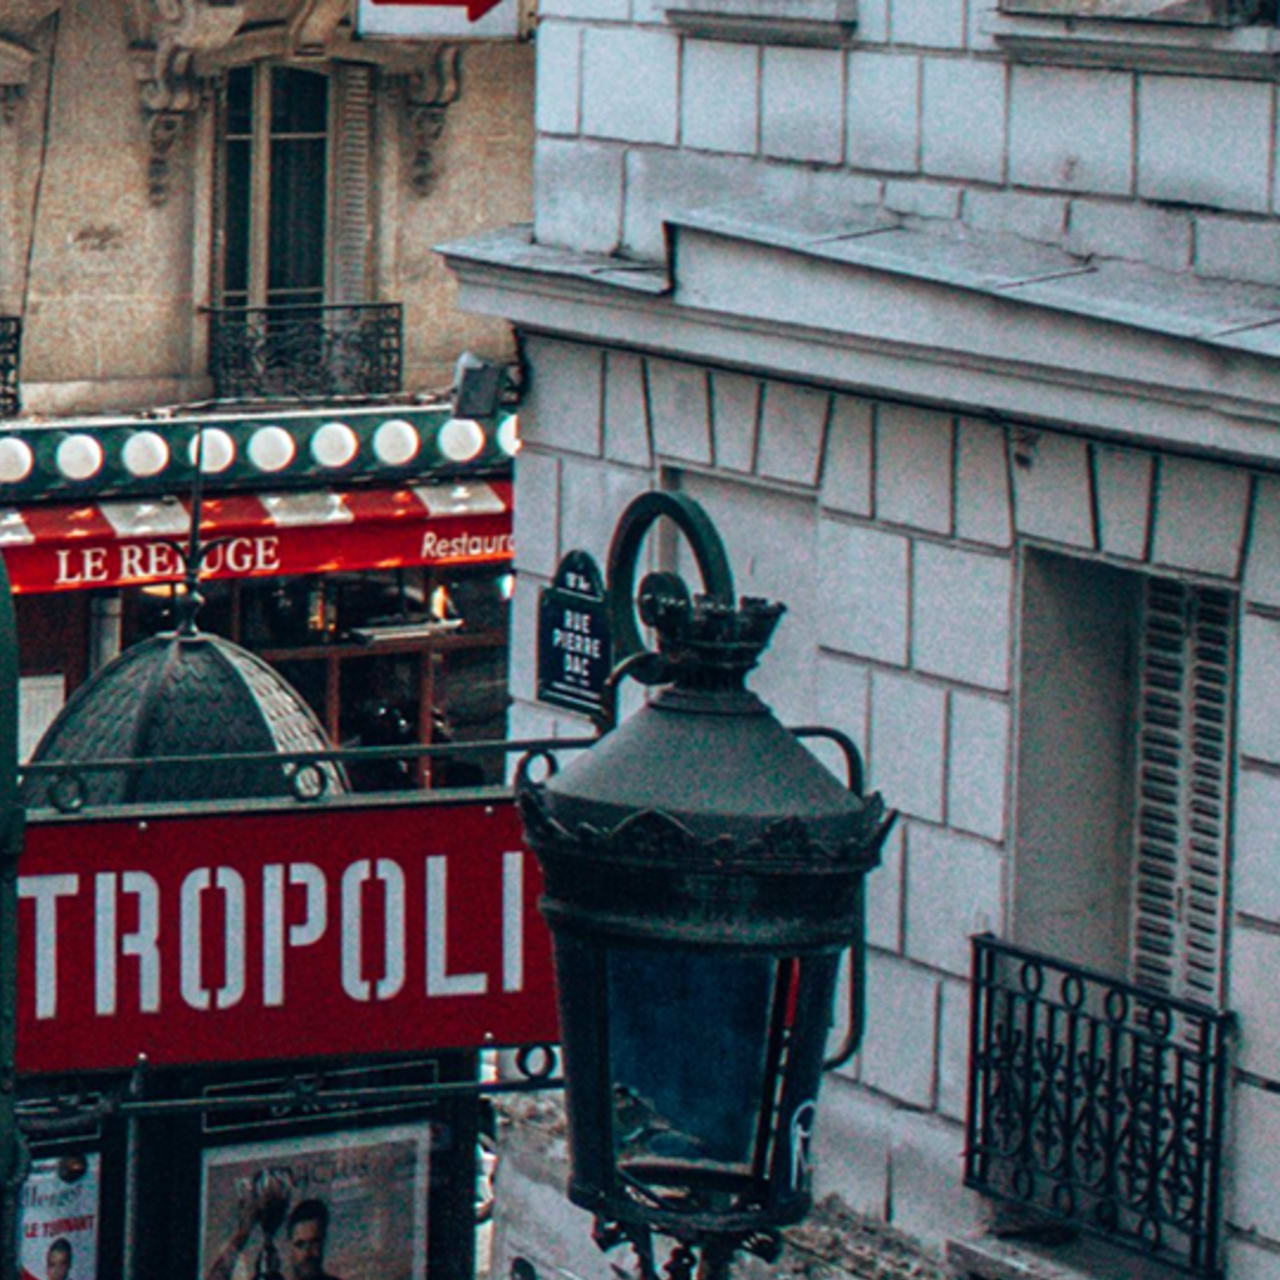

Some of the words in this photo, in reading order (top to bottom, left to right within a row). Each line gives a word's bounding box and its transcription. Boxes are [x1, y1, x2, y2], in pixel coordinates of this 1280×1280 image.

[55, 548, 108, 584] LE
[564, 610, 590, 634] RUE
[553, 628, 601, 659] PIERRE
